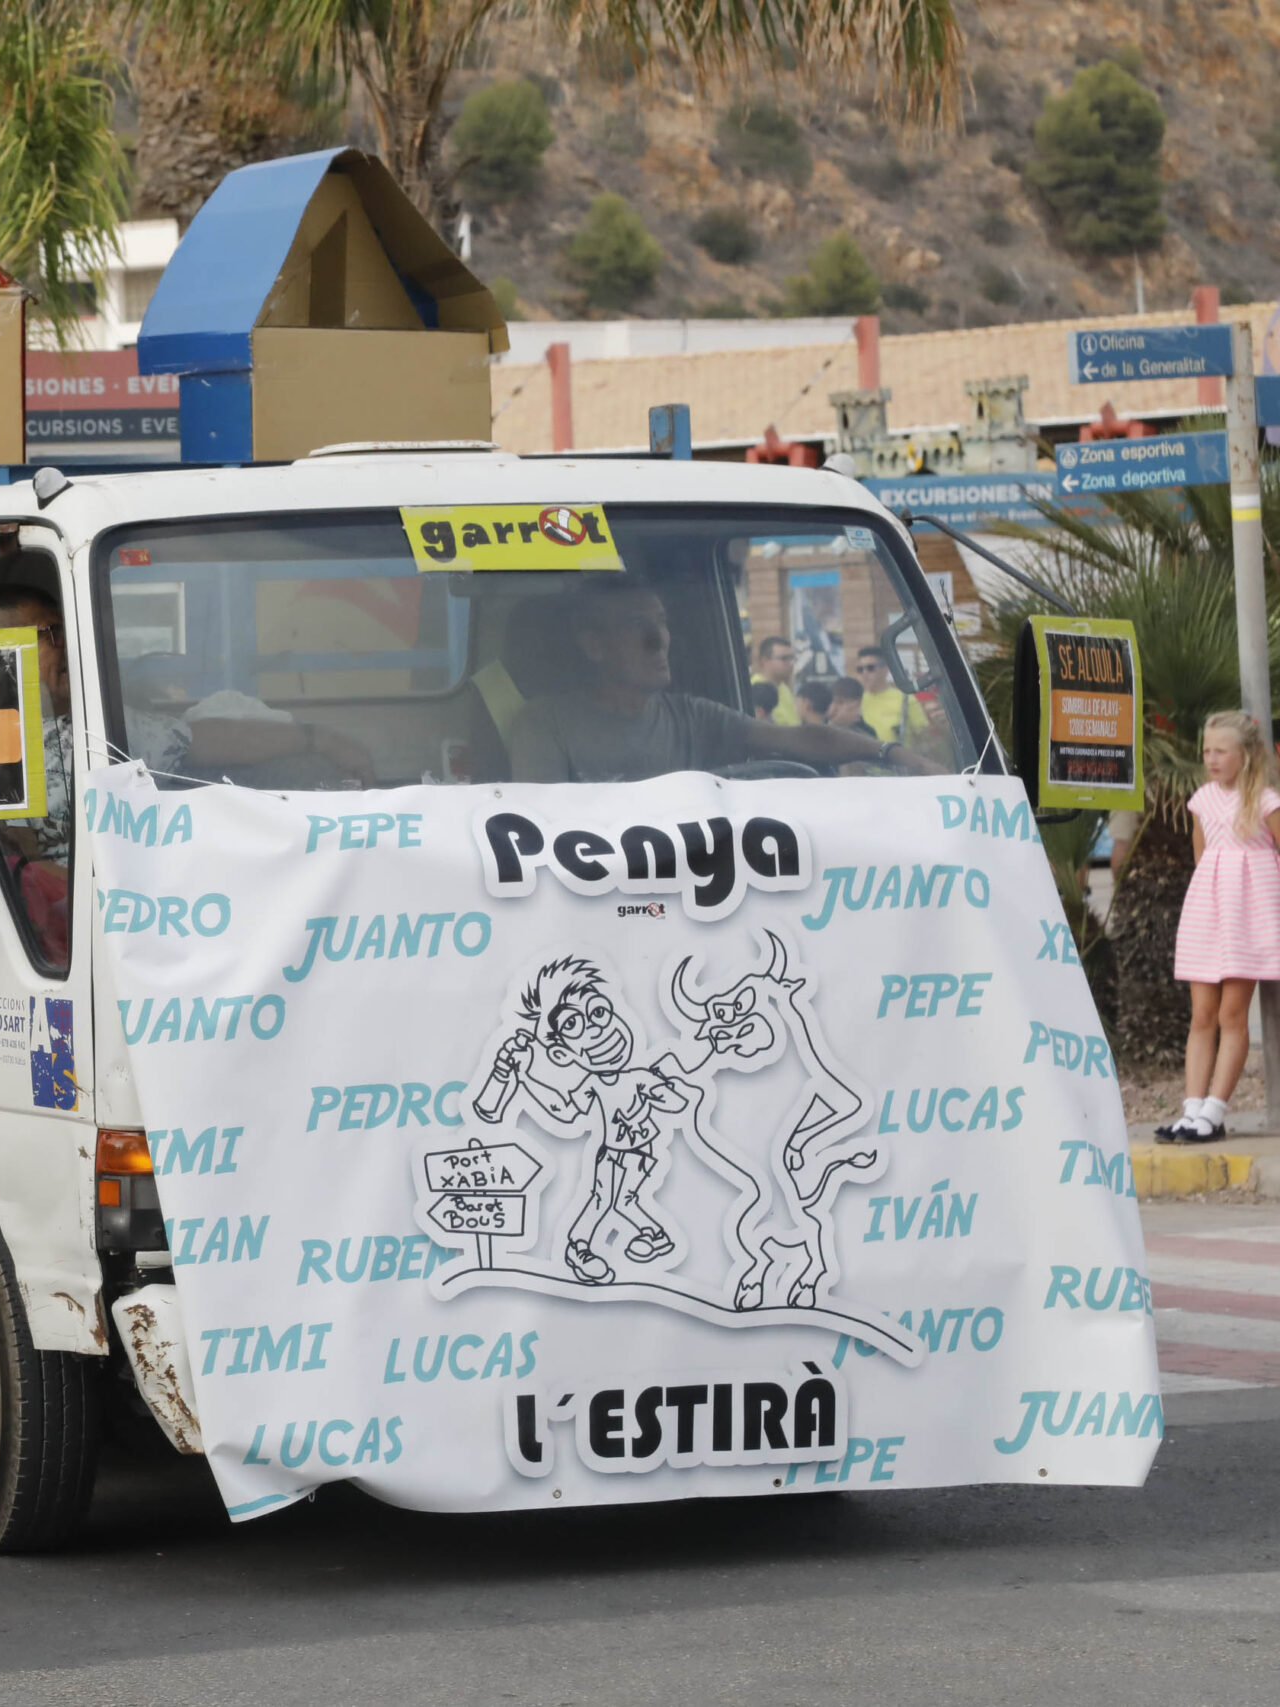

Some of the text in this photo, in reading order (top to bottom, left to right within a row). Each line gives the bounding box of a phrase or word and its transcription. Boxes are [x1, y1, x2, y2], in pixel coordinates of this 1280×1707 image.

[1099, 334, 1146, 351] Oficina
[1101, 357, 1206, 378] de la Generalitat
[1080, 441, 1185, 464] Zona esportiva
[880, 484, 1020, 507] EXCURSIONES
[1081, 468, 1186, 490] Zona deportiva
[1058, 644, 1124, 683] SE ALQUILA
[306, 813, 423, 853] PEPE
[485, 812, 800, 908] Penya
[801, 864, 990, 931] JUANTO
[282, 911, 491, 983] JUANTO
[1036, 919, 1082, 967] XE
[116, 994, 285, 1045] UANTO
[876, 973, 992, 1019] PEPE
[877, 1086, 1026, 1135] LUCAS
[443, 1150, 491, 1169] Port
[863, 1179, 978, 1242] IVÁN
[165, 1215, 271, 1266] IAN
[201, 1323, 332, 1376] TIMI
[383, 1330, 539, 1384] LUCAS
[243, 1416, 404, 1467] LUCAS
